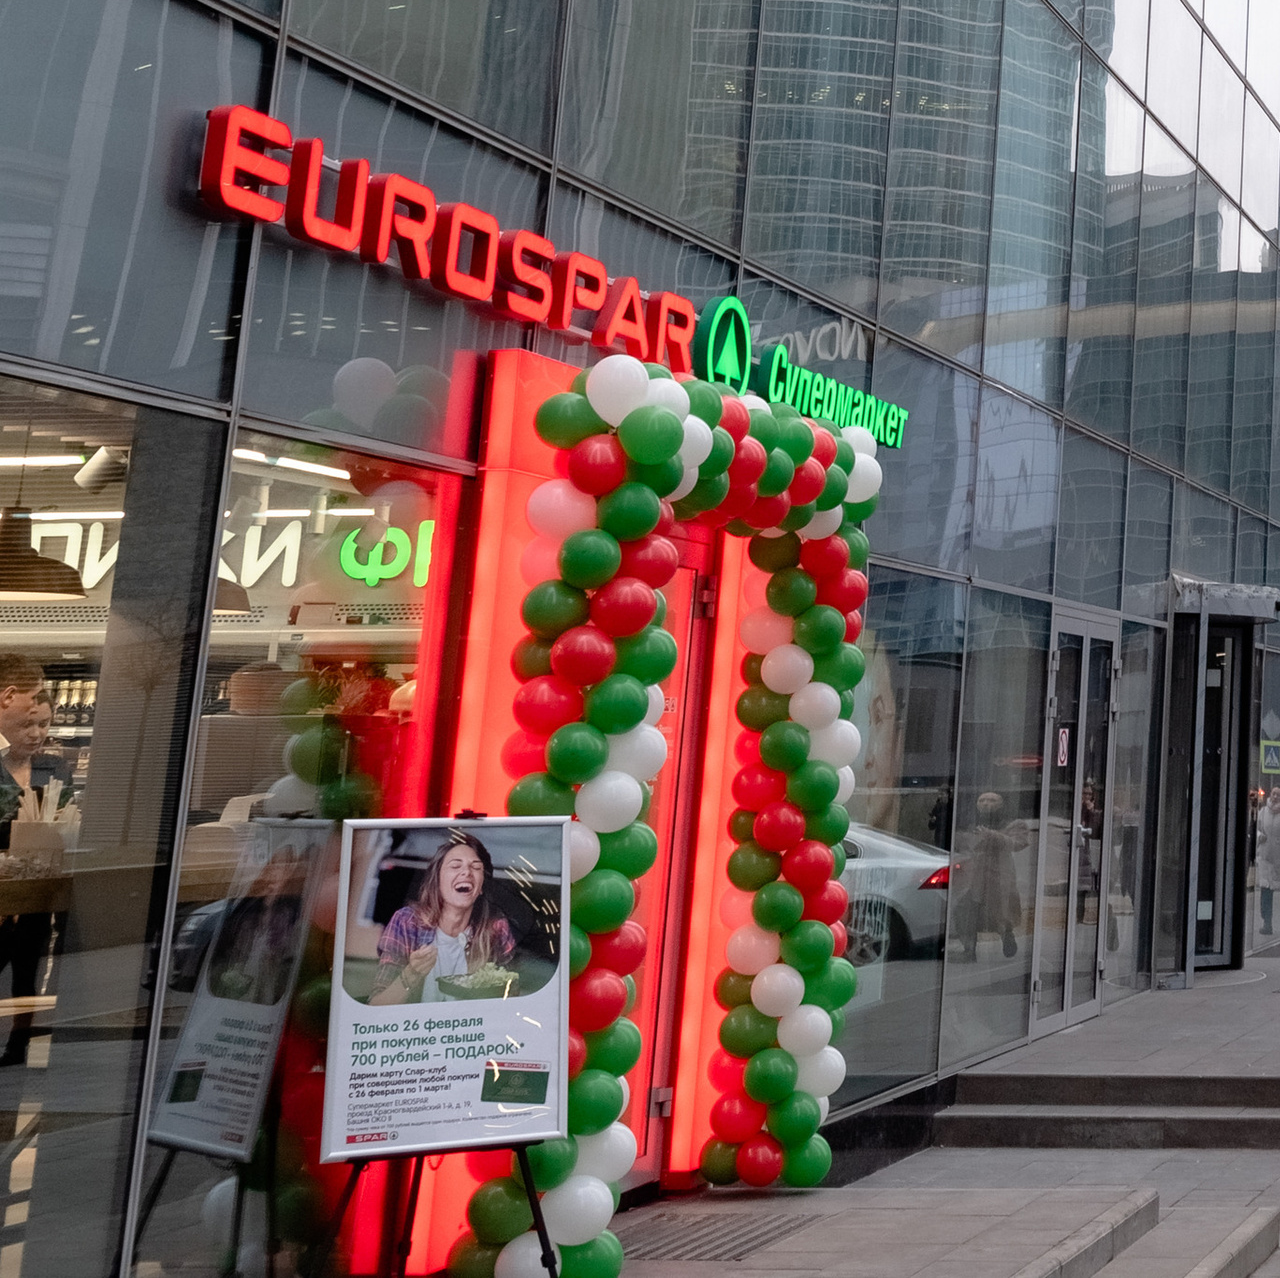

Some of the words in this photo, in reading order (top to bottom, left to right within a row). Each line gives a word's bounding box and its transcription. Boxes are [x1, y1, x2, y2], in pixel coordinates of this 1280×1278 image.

[200, 105, 696, 373] EUROSPAR
[768, 343, 910, 450] Супермаркет
[352, 1022, 399, 1035] Только
[403, 1019, 420, 1032] 26
[423, 1017, 483, 1033] февраля
[351, 1040, 377, 1053] при
[381, 1035, 437, 1050] покупке
[440, 1032, 486, 1044] свыше
[351, 1053, 377, 1067] 700
[380, 1049, 430, 1068] рублей
[349, 1072, 379, 1082] Дарим
[380, 1070, 404, 1079] карту
[405, 1064, 447, 1077] Спар-клуб
[349, 1082, 365, 1091] при
[366, 1078, 418, 1089] совершении
[419, 1074, 446, 1085] любой
[447, 1073, 480, 1083] покупки
[355, 1089, 366, 1099] 26
[367, 1087, 405, 1098] февраля
[406, 1086, 417, 1094] по
[423, 1082, 452, 1094] марта!
[355, 1133, 388, 1143] SPAR
